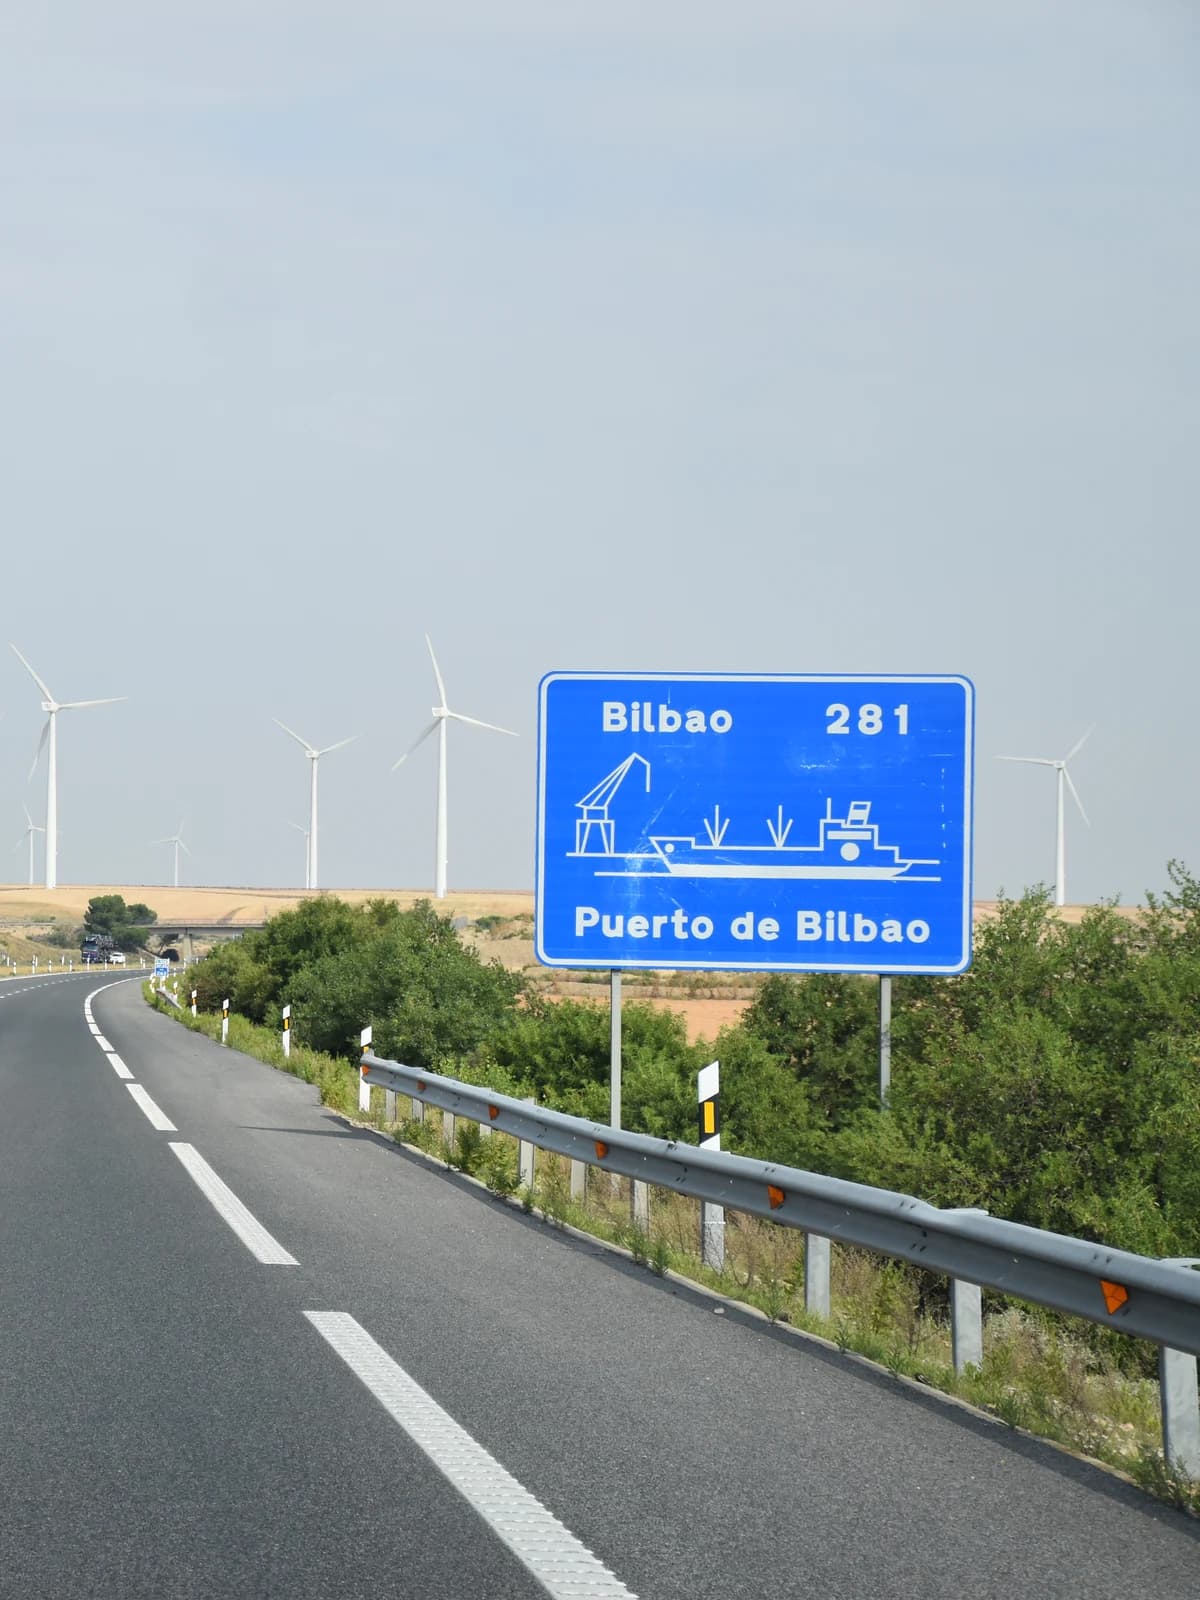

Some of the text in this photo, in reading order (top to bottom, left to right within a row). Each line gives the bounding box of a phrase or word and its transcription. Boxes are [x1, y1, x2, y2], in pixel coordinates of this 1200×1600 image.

[603, 701, 908, 735] Bilbao 281
[575, 906, 930, 943] Puerto de Bilbao
